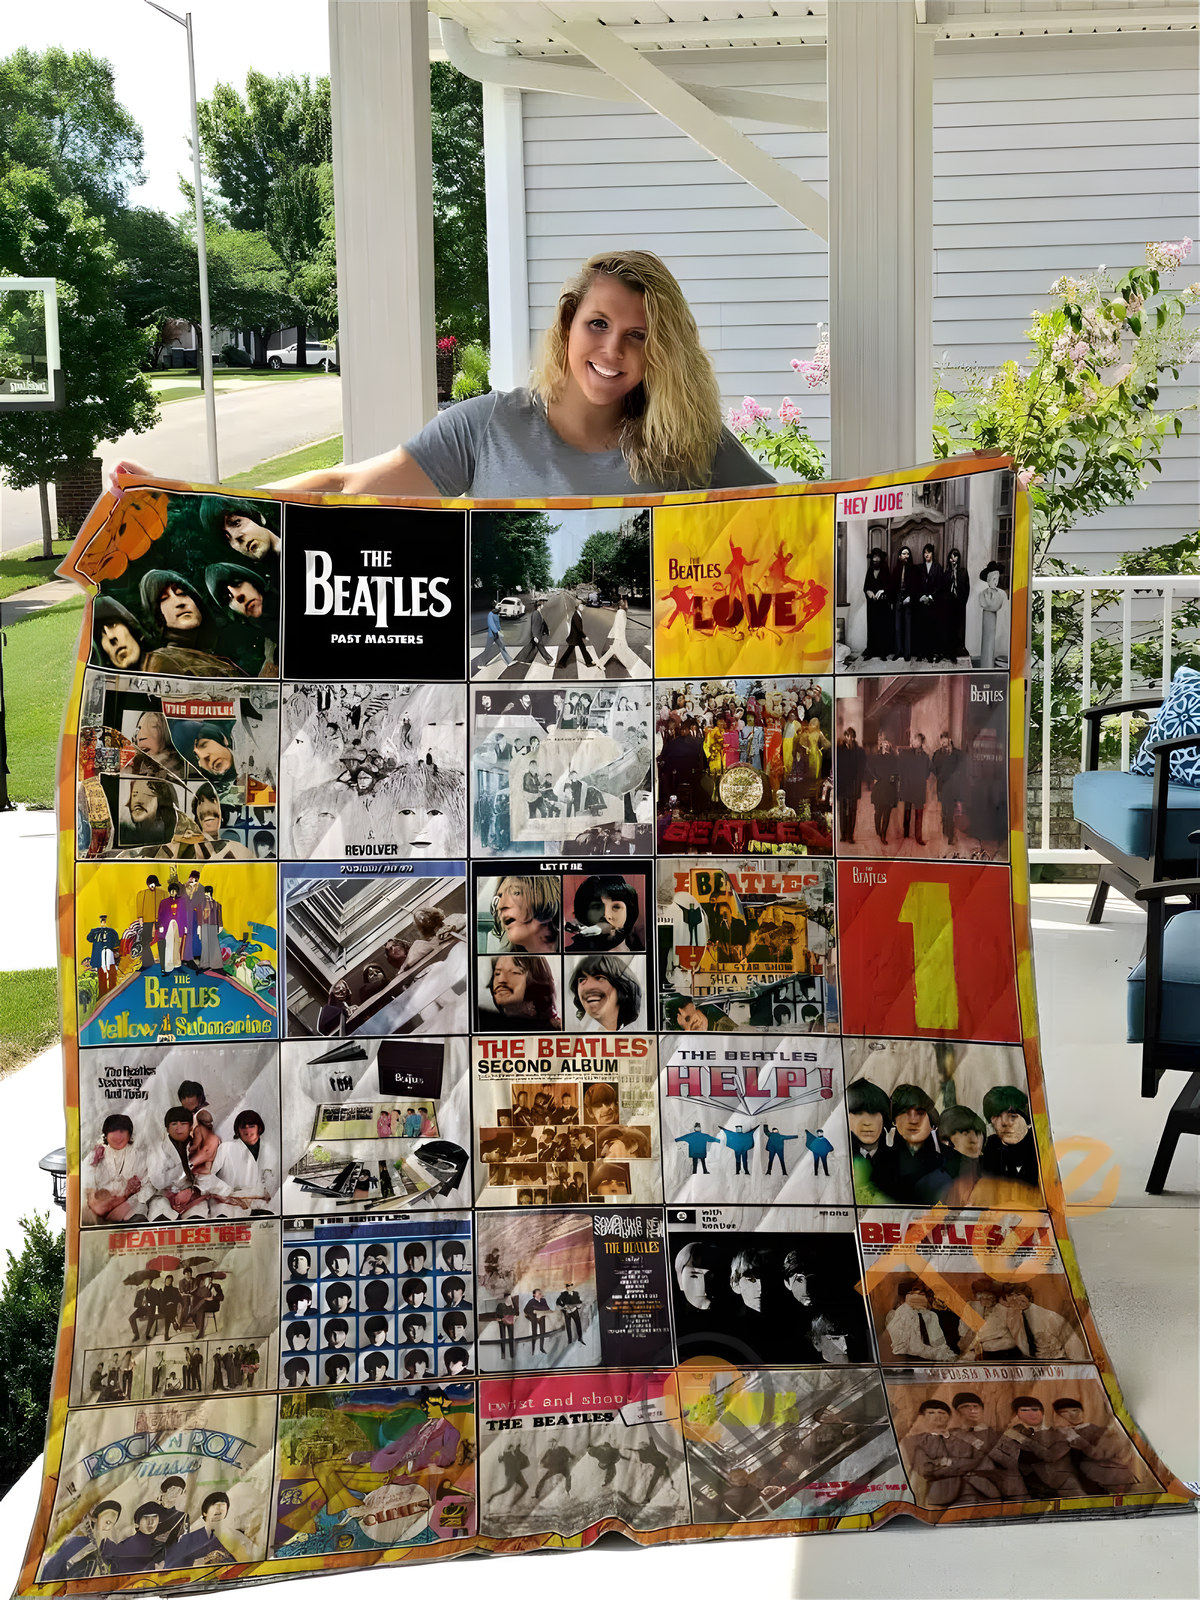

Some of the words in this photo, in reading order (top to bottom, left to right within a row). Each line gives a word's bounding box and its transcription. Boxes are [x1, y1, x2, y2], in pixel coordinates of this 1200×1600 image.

[843, 497, 868, 515] HEY
[873, 491, 903, 513] JUDE
[360, 550, 392, 567] THE
[669, 558, 721, 582] BEATLES
[304, 550, 452, 628] BEATLES
[693, 591, 797, 630] LOVE
[331, 634, 362, 644] PAST
[365, 634, 424, 645] MASTERS
[970, 684, 1004, 705] BEATLES
[345, 844, 398, 856] REVOLVER
[897, 881, 959, 1030] 1
[174, 975, 190, 984] THE
[710, 974, 738, 985] SHEA
[144, 975, 221, 1014] BEATLES
[98, 1009, 158, 1040] Yellow
[175, 1014, 272, 1036] Submarine
[478, 1039, 525, 1059] THE
[678, 1050, 717, 1061] THE
[725, 1050, 818, 1062] BEATLES
[478, 1059, 551, 1074] SECOND
[561, 1059, 618, 1073] ALBUM
[666, 1066, 834, 1099] HELP!
[109, 1227, 211, 1249] BEATLES
[486, 1418, 523, 1431] THE
[533, 1412, 615, 1428] BEATLES
[82, 1431, 165, 1480] ROCK
